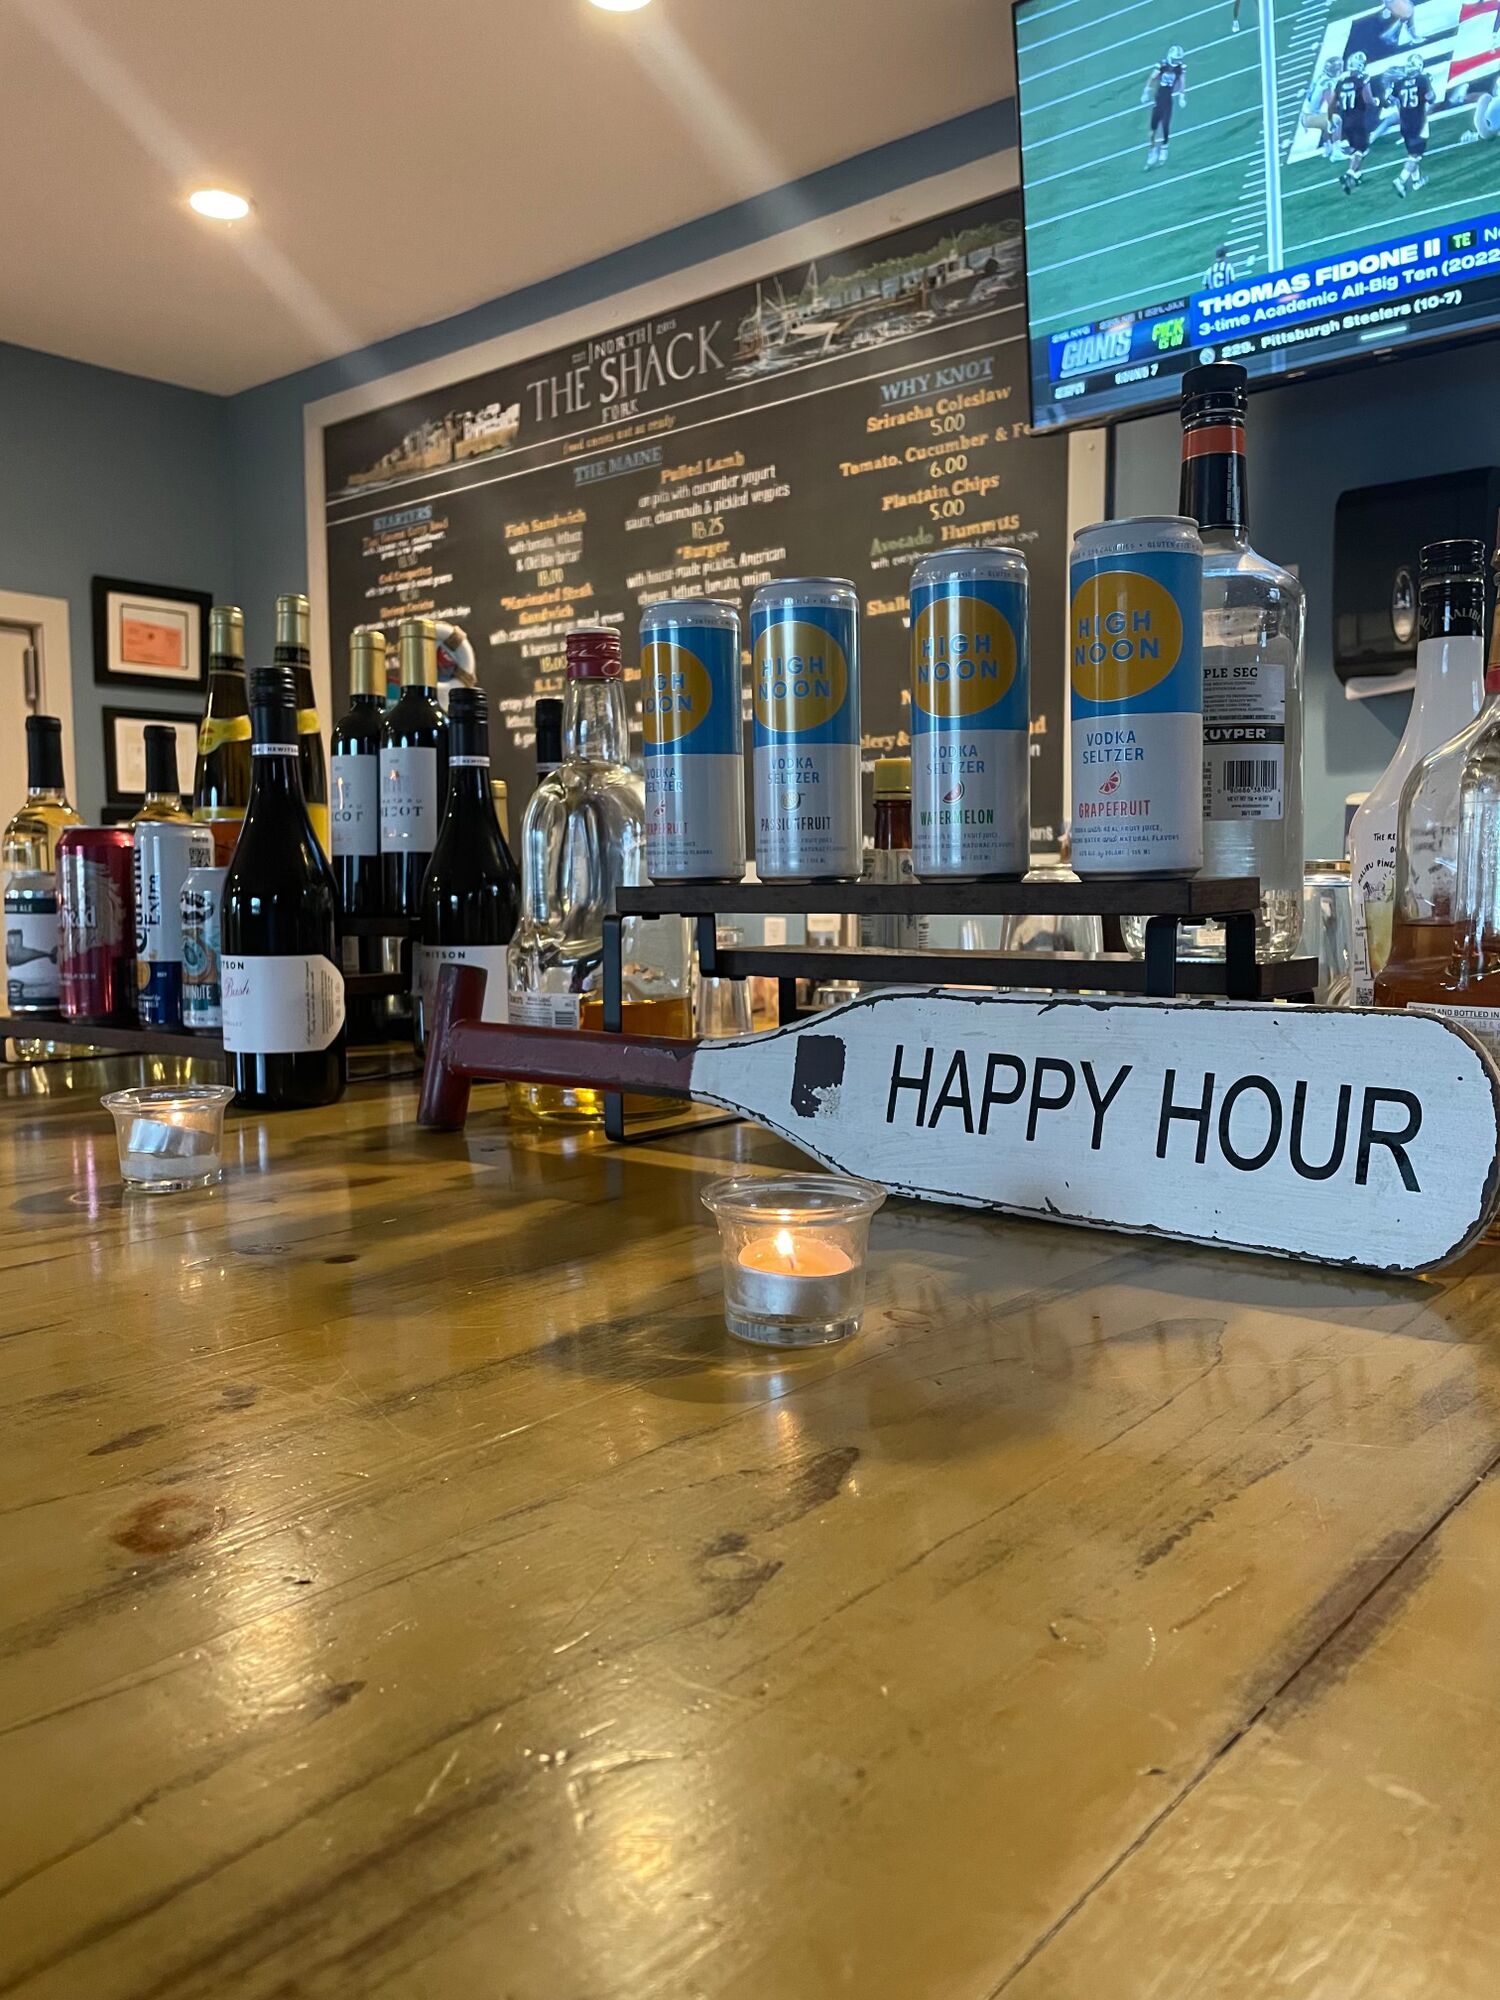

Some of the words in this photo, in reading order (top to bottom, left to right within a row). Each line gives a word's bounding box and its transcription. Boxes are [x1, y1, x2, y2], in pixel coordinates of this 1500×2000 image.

[1340, 89, 1357, 111] 77
[1400, 86, 1419, 108] 75
[1452, 231, 1472, 249] TE
[1198, 272, 1311, 317] THOMAS
[1315, 243, 1419, 287] FIDONE
[1424, 237, 1441, 259] II
[1198, 312, 1251, 336] 3-time
[1253, 290, 1339, 323] Academic
[1340, 274, 1400, 300] All-Big
[1401, 268, 1439, 285] Ten
[1152, 316, 1185, 342] PICK
[1260, 320, 1341, 349] Pittsburgh
[1342, 303, 1412, 330] Steelers
[1413, 289, 1462, 314] (10-7)
[594, 327, 647, 359] NORTH
[1061, 326, 1133, 371] GIANTS
[526, 365, 591, 422] THE
[599, 320, 725, 403] SHACK
[881, 373, 931, 401] WHY
[935, 357, 995, 387] KNOT
[602, 399, 639, 423] FORK
[866, 406, 935, 433] Sriracha
[936, 386, 1012, 416] Coleslaw
[930, 413, 966, 436] 5.00
[905, 433, 990, 463] Cucumber
[995, 426, 1008, 442] &
[573, 461, 606, 483] THE
[608, 446, 663, 473] MAINE
[706, 450, 746, 473] Lamb
[929, 455, 968, 479] 6.00
[881, 485, 950, 511] Plantain
[951, 474, 1001, 497] Chips
[929, 498, 966, 521] 5.00
[870, 526, 935, 557] Avocado
[940, 514, 1021, 542] Hummus
[1078, 610, 1151, 639] HIGH
[922, 632, 993, 659] HIGH
[1074, 637, 1160, 667] NOON
[761, 654, 825, 677] HIGH
[917, 658, 999, 685] NOON
[1233, 667, 1258, 678] SEC
[757, 679, 831, 701] NOON
[1086, 730, 1137, 747] VODKA
[1203, 728, 1266, 741] KUYPER
[933, 743, 979, 759] VODKA
[1082, 747, 1145, 765] SELTZER
[770, 756, 815, 771] VODKA
[926, 759, 986, 776] SELTZER
[767, 771, 821, 786] SELTZER
[919, 808, 995, 826] WATERMELON
[1078, 799, 1151, 819] GRAPEFRUIT
[760, 815, 832, 832] PASSIONFRUIT
[1373, 833, 1385, 841] THE
[1453, 1009, 1490, 1018] BOTTLED
[886, 1044, 1134, 1151] HAPPY
[1155, 1068, 1423, 1194] HOUR
